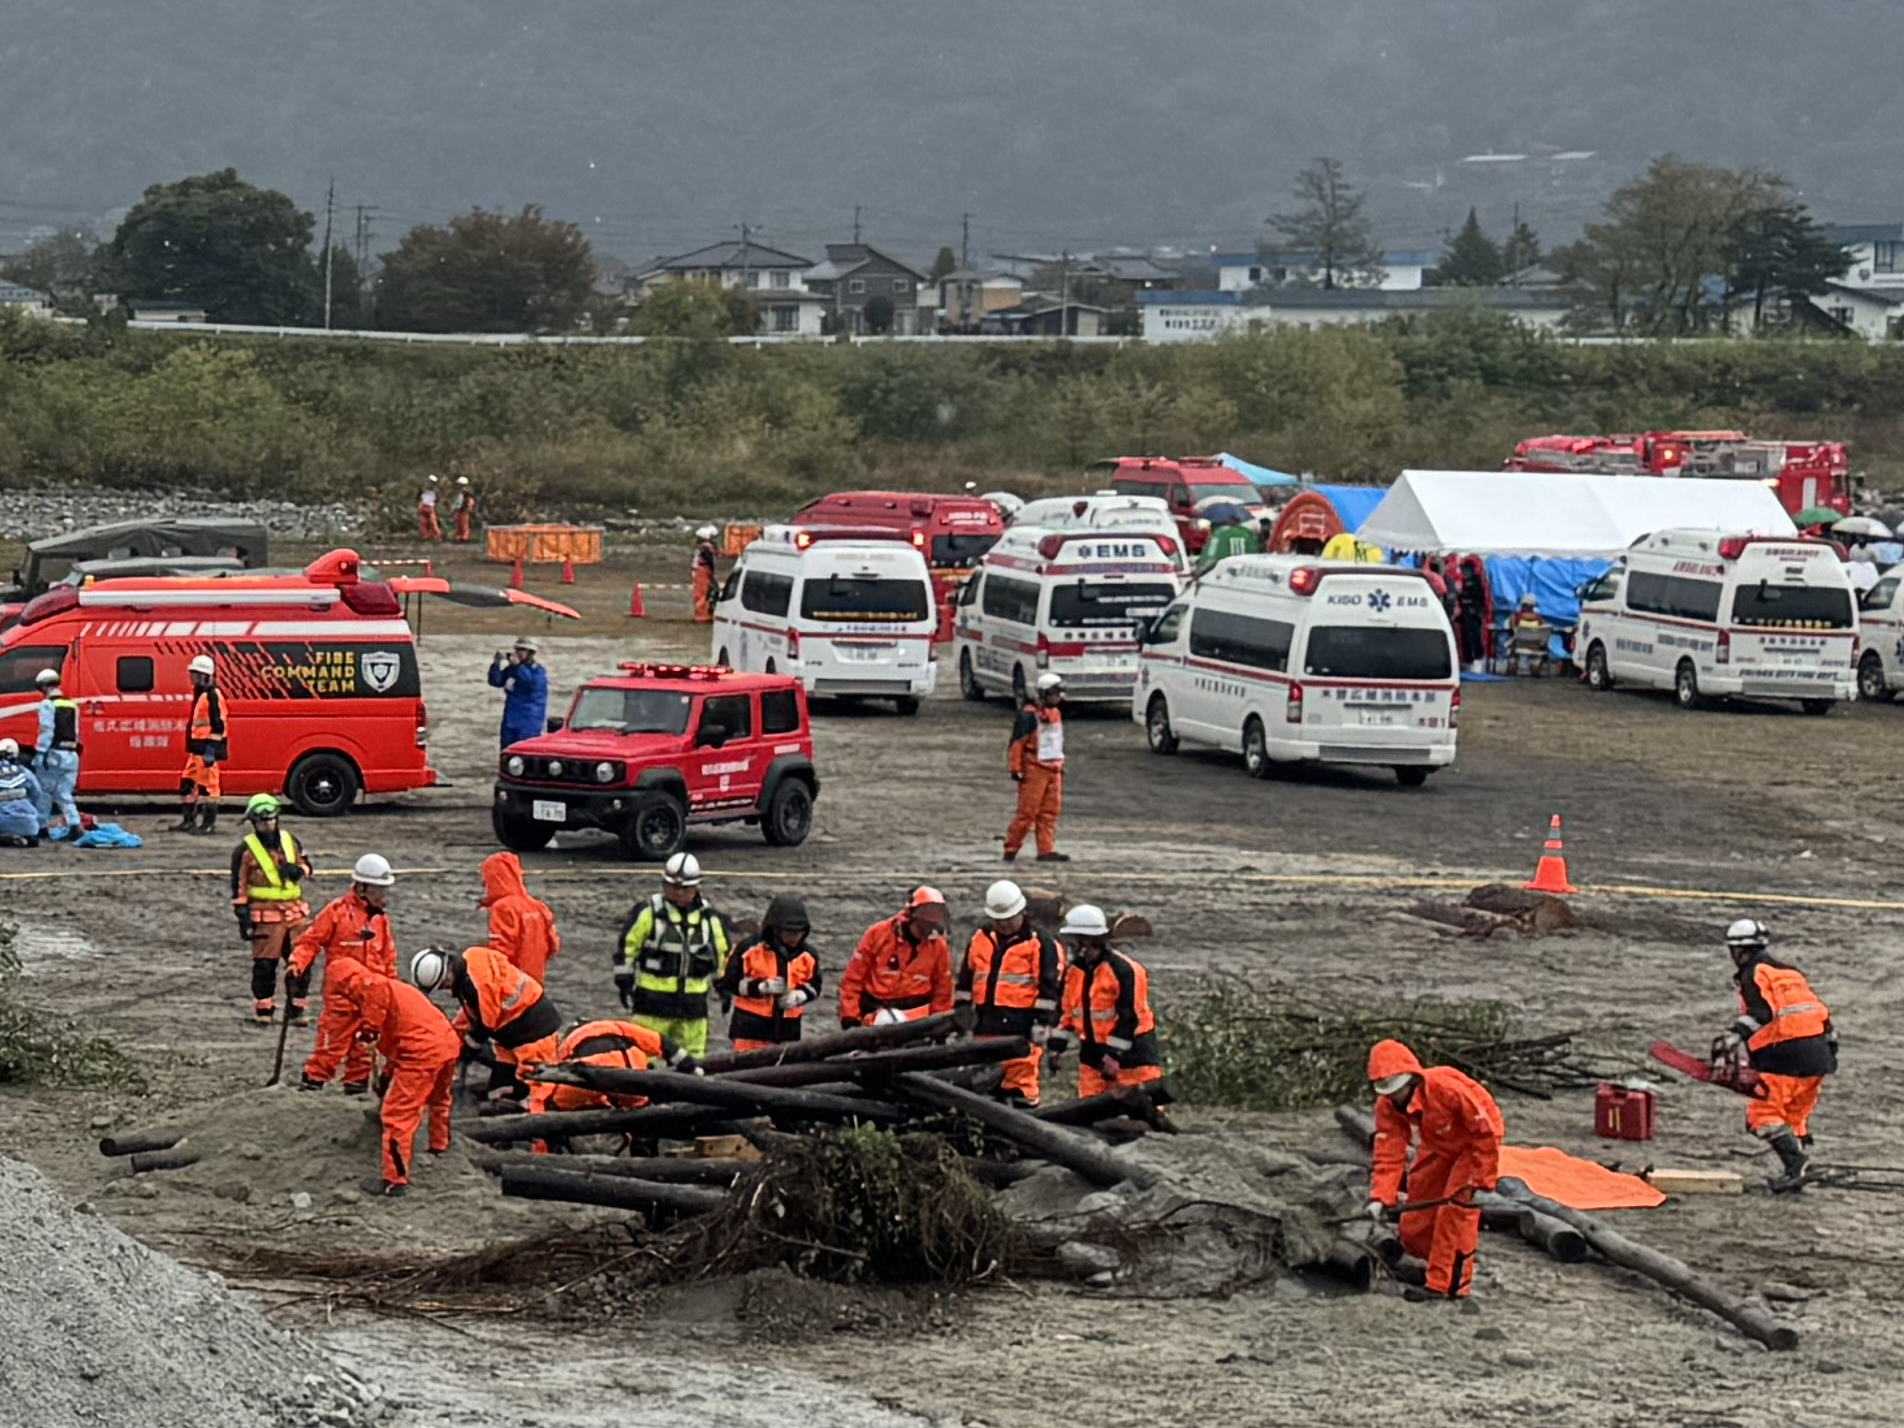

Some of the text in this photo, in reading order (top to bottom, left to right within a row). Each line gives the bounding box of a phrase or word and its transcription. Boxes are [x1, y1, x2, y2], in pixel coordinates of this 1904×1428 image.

[1097, 545, 1145, 558] EMS
[1327, 594, 1428, 607] KISO EMS
[316, 652, 355, 664] FIRE
[261, 666, 355, 679] COMMAND
[308, 680, 355, 693] TEAM
